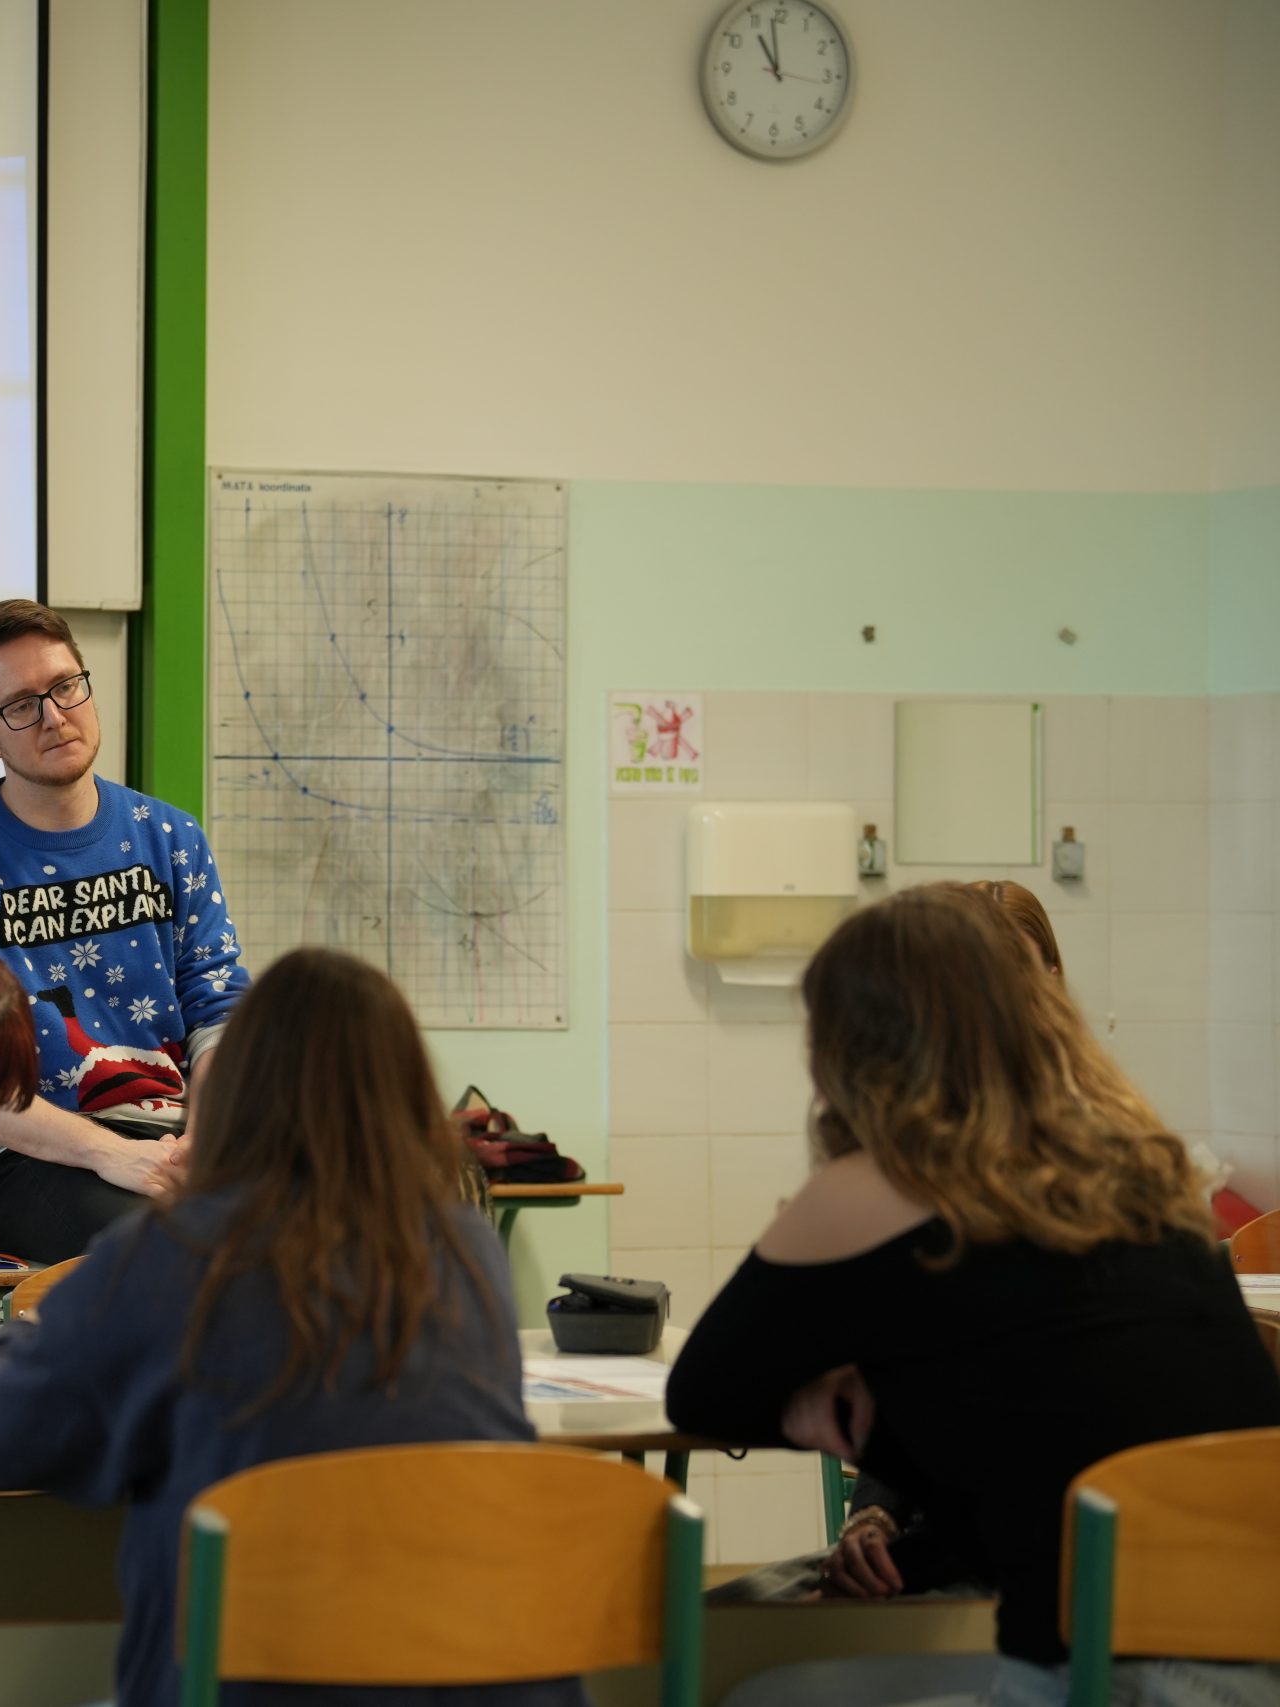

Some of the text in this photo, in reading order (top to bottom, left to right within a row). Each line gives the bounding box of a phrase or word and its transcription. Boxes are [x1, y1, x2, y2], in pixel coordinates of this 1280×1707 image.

[817, 39, 826, 56] 2
[721, 60, 732, 76] 9
[822, 68, 832, 84] 3
[727, 90, 737, 106] 8
[768, 123, 779, 137] 6
[794, 115, 805, 131] 5
[2, 886, 68, 916] DEAR
[70, 893, 173, 934] EXPLAN.
